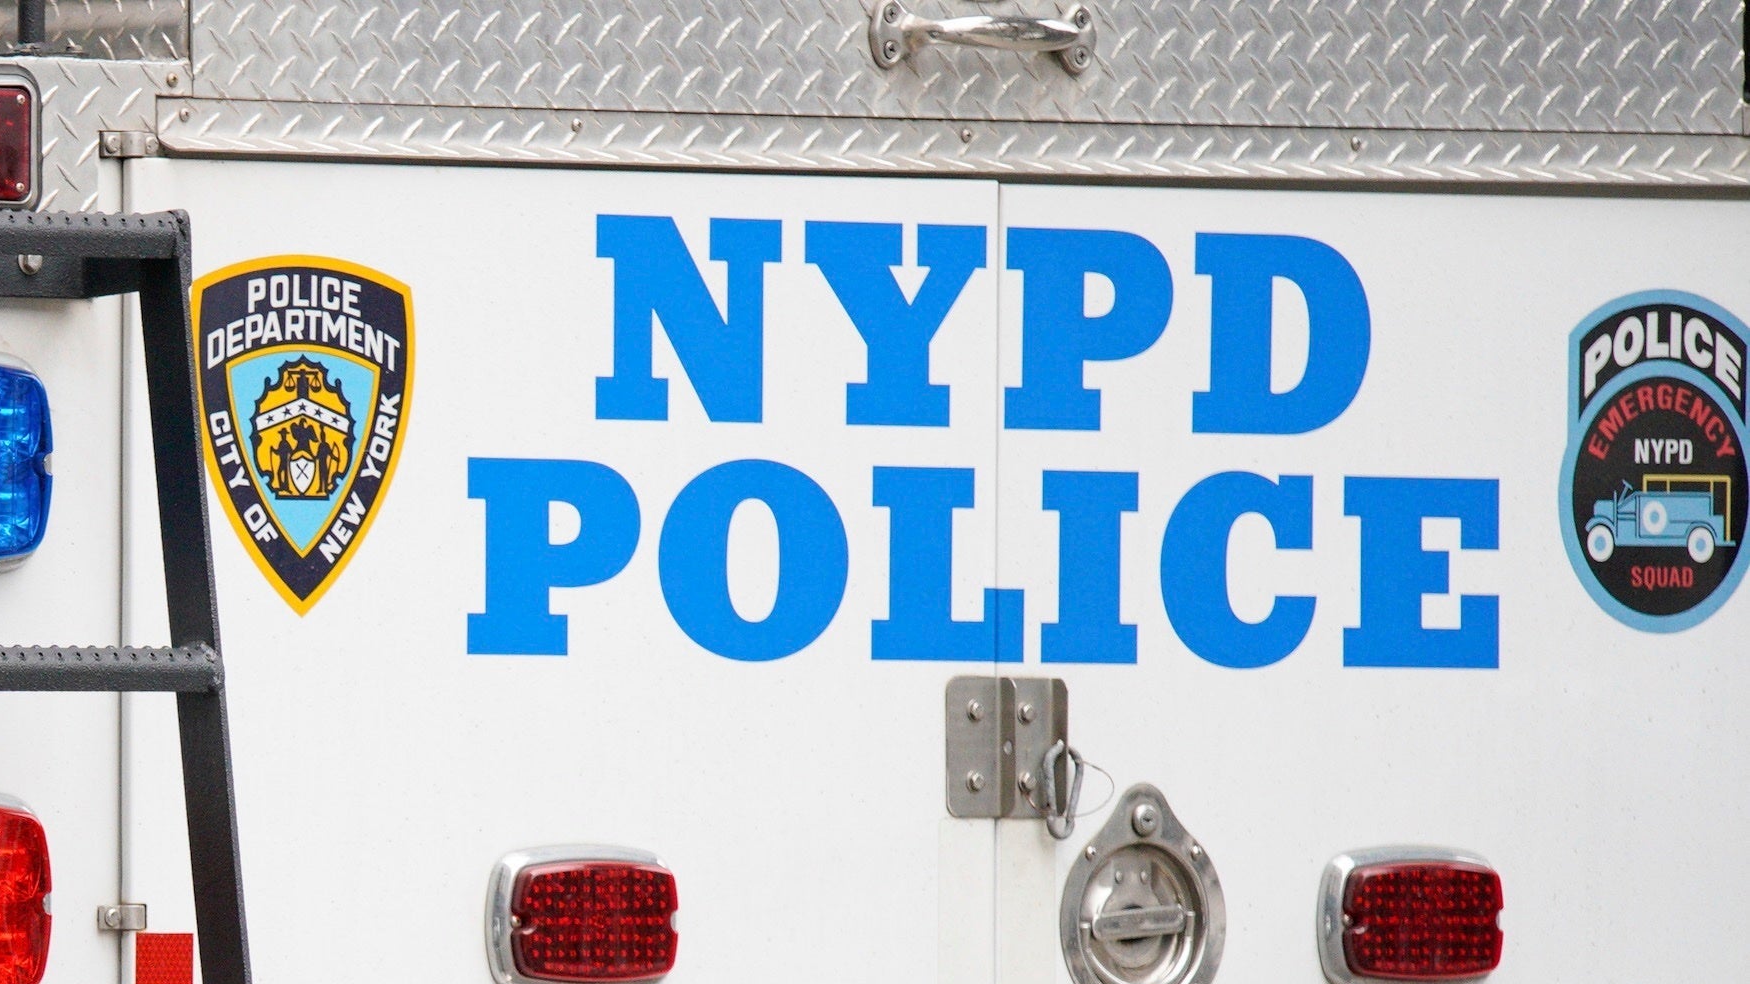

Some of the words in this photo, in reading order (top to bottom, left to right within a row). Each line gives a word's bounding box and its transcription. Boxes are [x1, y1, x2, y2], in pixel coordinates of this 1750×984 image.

[247, 274, 362, 318] POLICE
[595, 213, 1372, 436] NYPD
[206, 308, 401, 372] DEPARTMENT
[1583, 310, 1742, 401] POLICE
[1587, 382, 1737, 461] EMERGENCY
[1634, 437, 1694, 466] NYPD
[209, 409, 251, 490] CITY
[242, 503, 279, 543] OF
[318, 492, 367, 565] NEW
[360, 392, 401, 480] YORK
[467, 456, 1500, 670] POLICE
[1630, 565, 1694, 591] SQUAD
